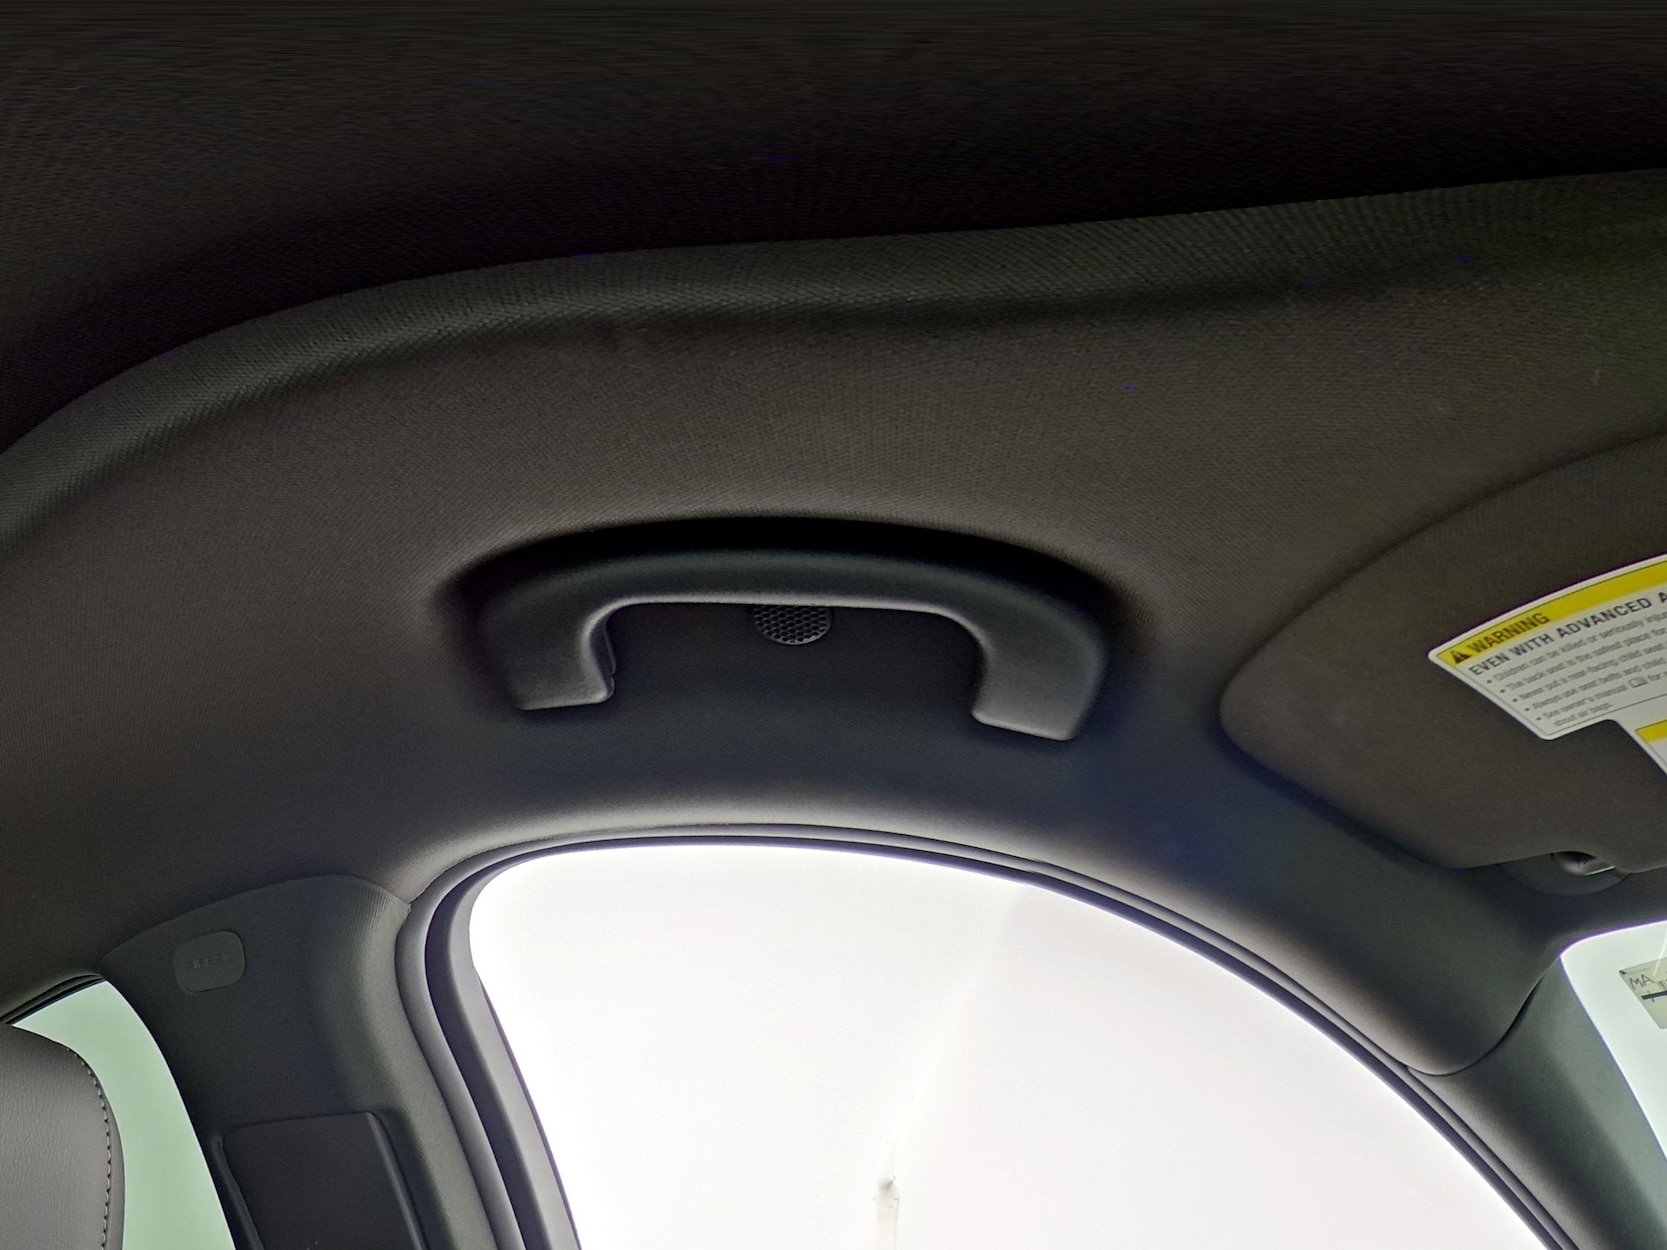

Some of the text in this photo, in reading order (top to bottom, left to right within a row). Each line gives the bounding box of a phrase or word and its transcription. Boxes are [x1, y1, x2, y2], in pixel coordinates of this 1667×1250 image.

[1466, 612, 1551, 653] WARNING
[1468, 653, 1510, 675] EVEN
[1509, 633, 1554, 656] WITH
[1556, 597, 1652, 638] ADVANCED
